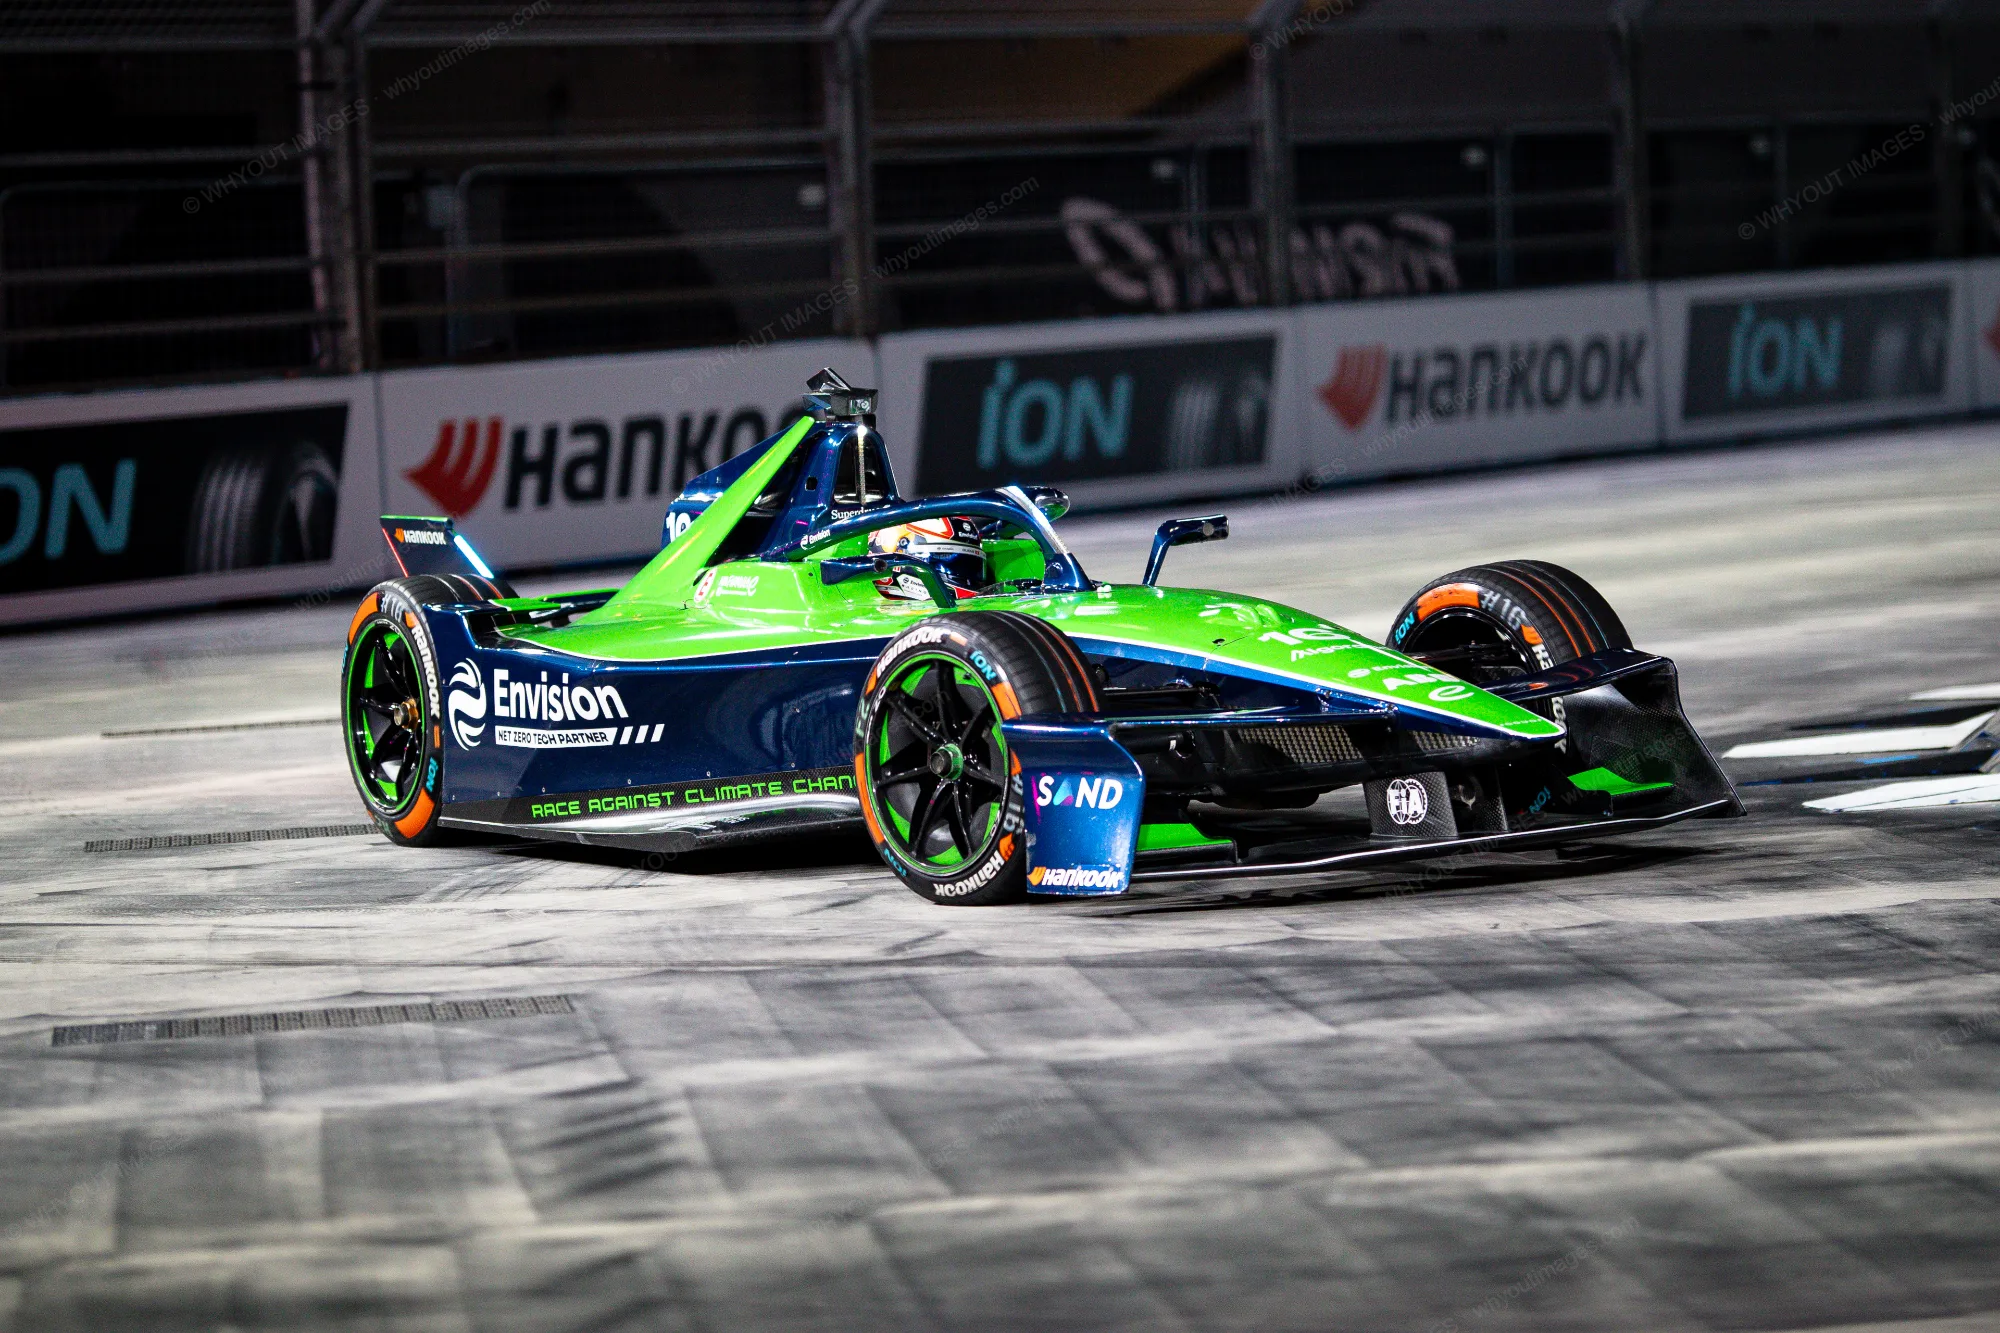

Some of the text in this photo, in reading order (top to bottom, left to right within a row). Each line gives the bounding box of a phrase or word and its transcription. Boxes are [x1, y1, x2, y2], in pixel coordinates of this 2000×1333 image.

[493, 668, 629, 722] Envision
[498, 730, 609, 745] NET ZERO TECH PARTNER
[531, 774, 858, 819] RACE AGAINST CLIMATE CHAN
[1387, 786, 1426, 817] FIA
